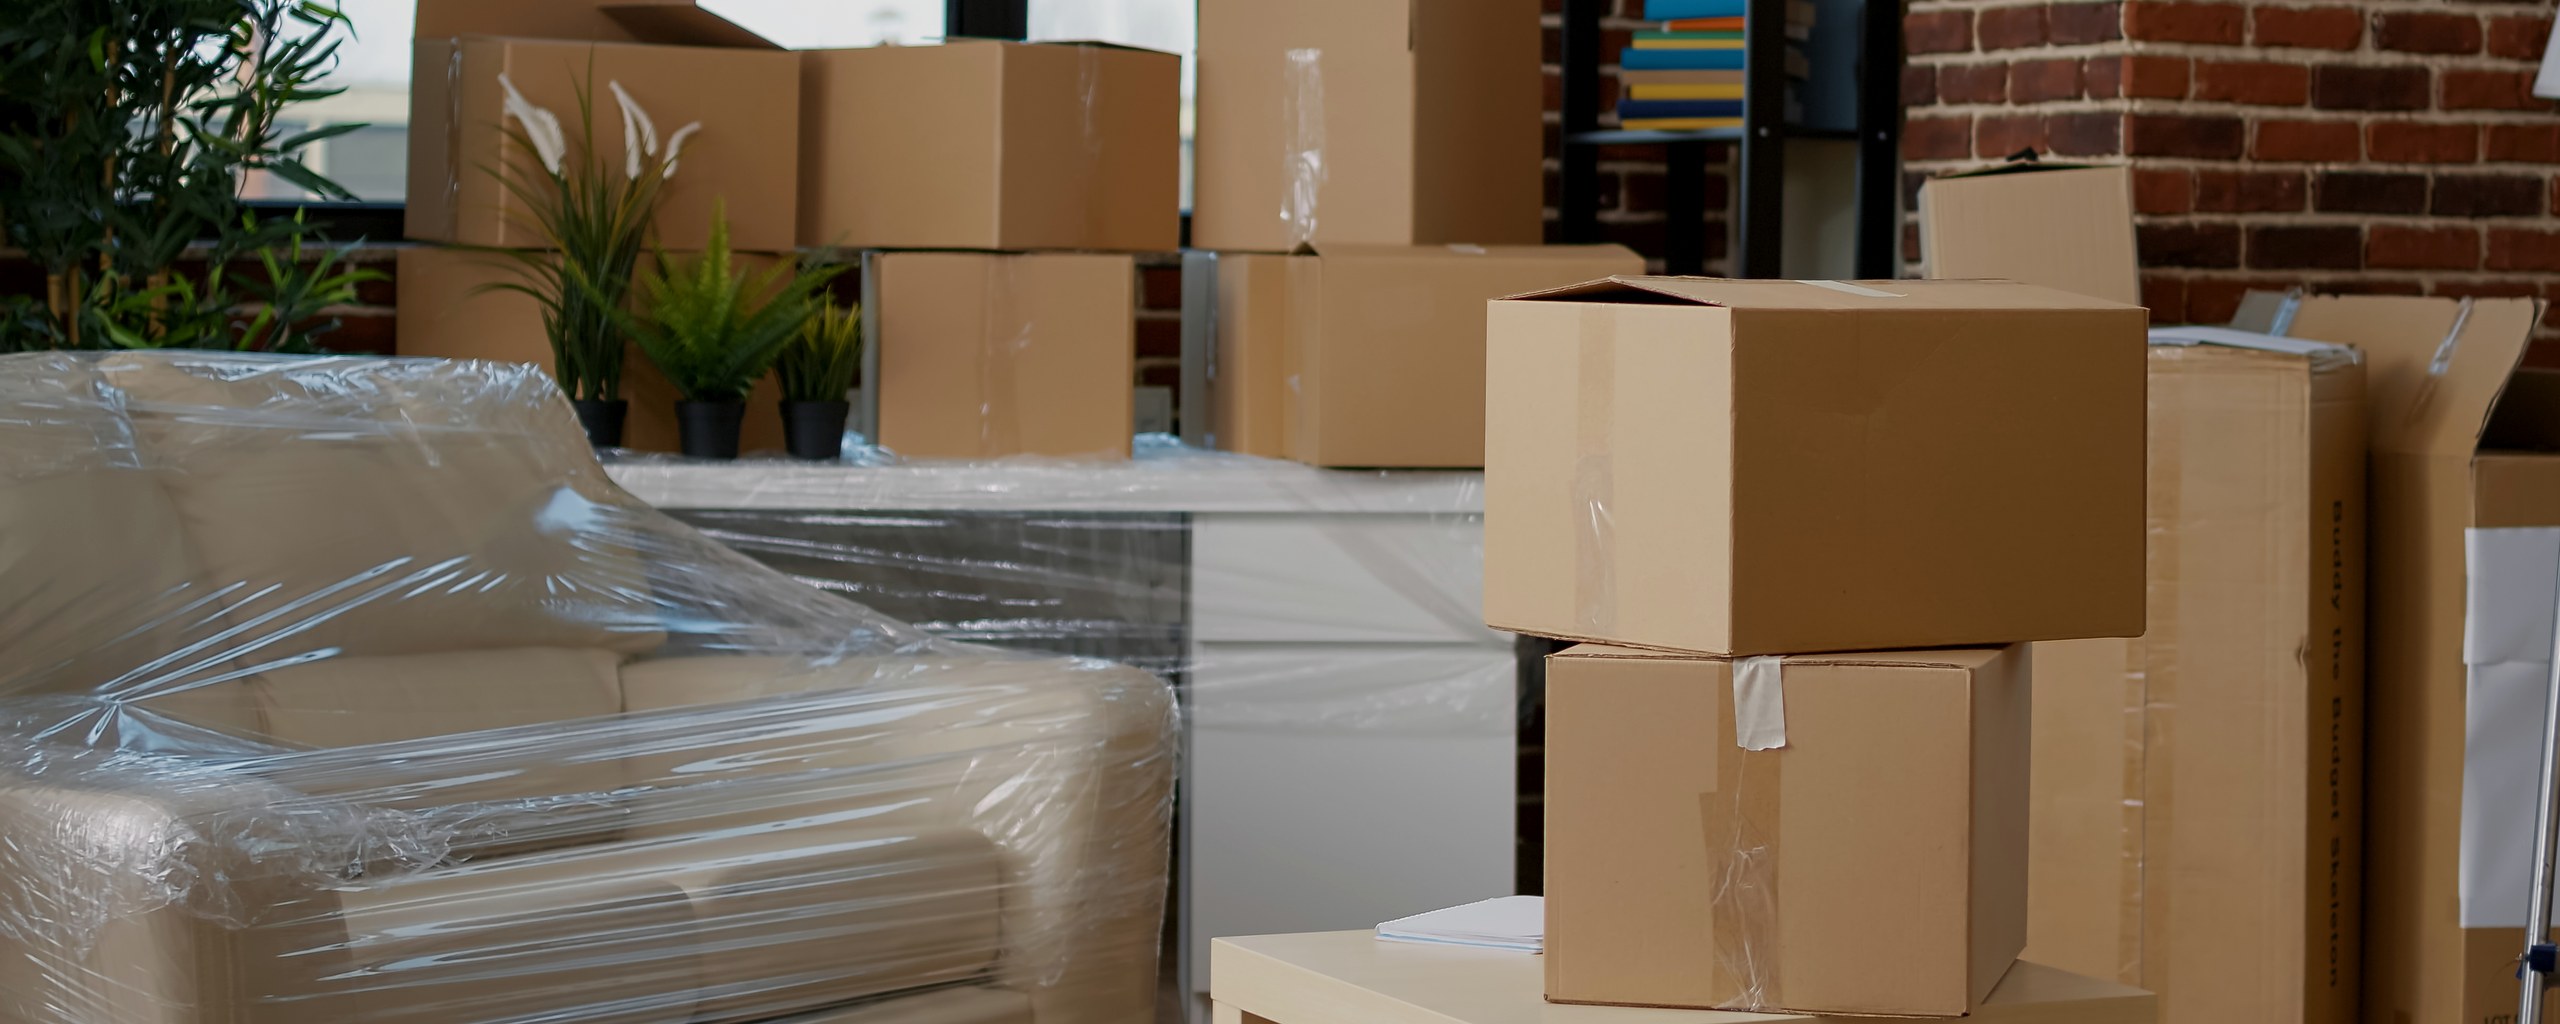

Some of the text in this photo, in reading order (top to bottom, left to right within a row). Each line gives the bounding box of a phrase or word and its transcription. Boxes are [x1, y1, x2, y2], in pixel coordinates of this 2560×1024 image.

[2329, 500, 2343, 987] Buddy the Budget Skeleton
